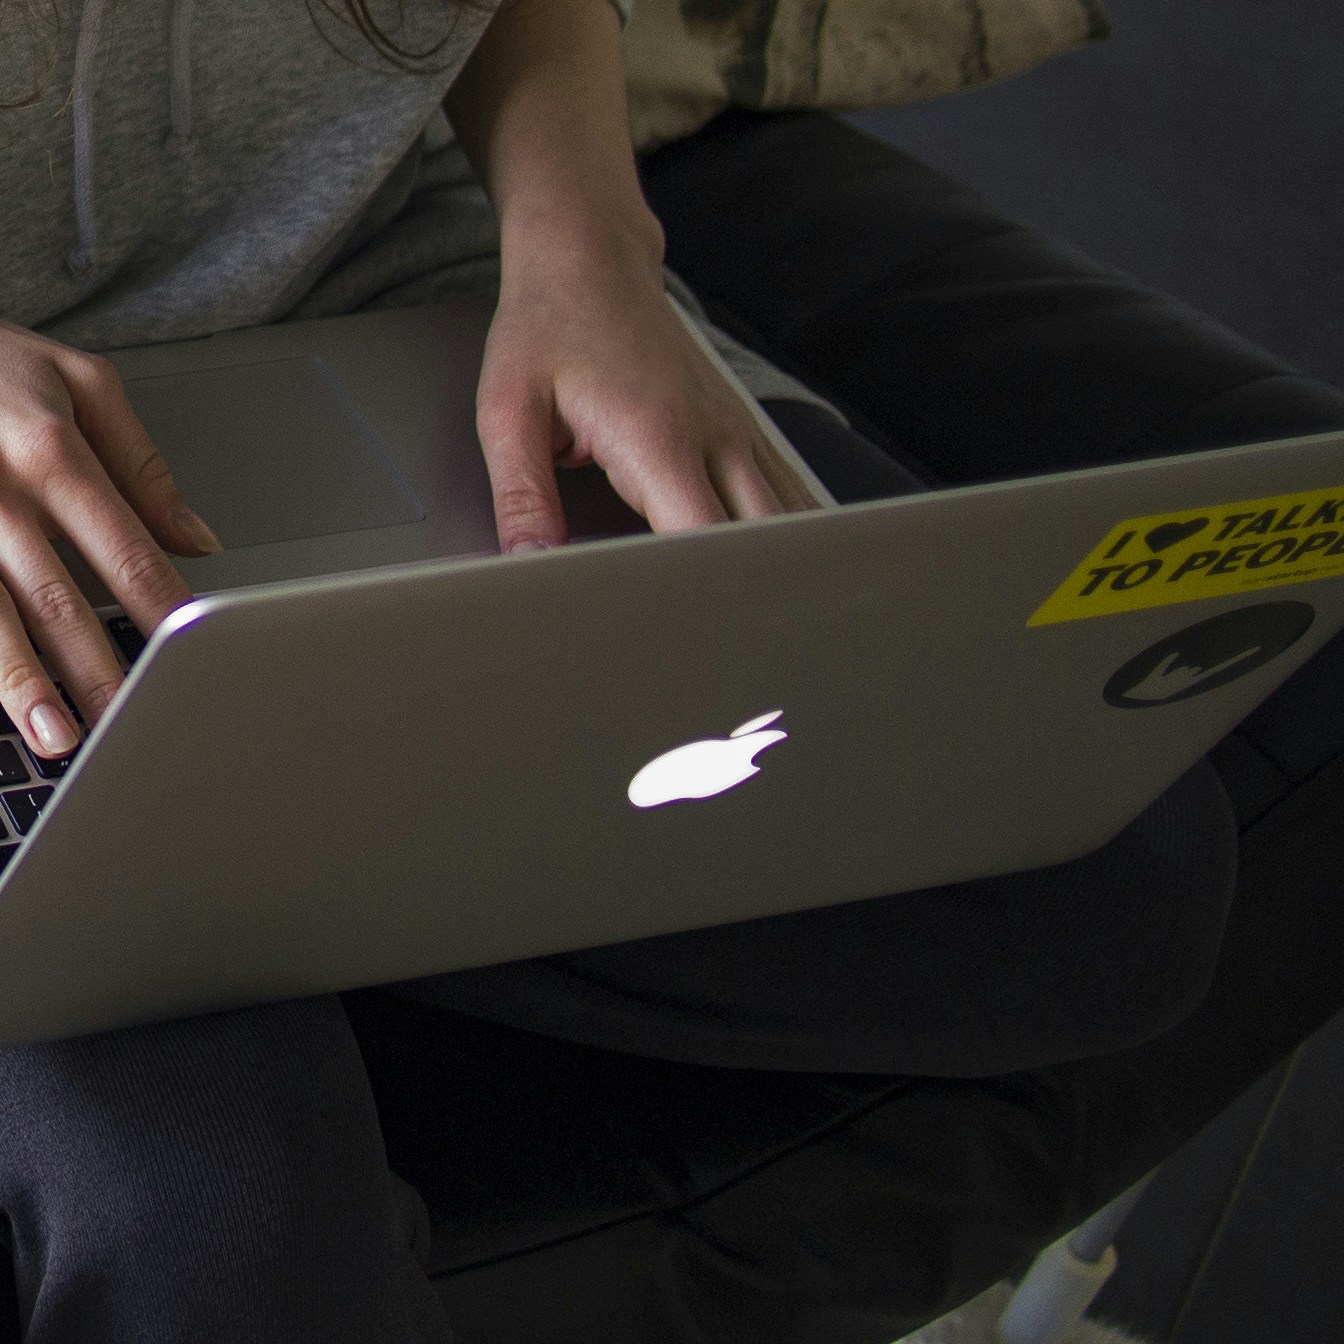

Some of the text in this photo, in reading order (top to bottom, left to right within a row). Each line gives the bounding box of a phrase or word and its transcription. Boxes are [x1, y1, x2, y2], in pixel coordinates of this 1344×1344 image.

[1102, 497, 1344, 559] I TALK
[1078, 559, 1164, 596] TO
